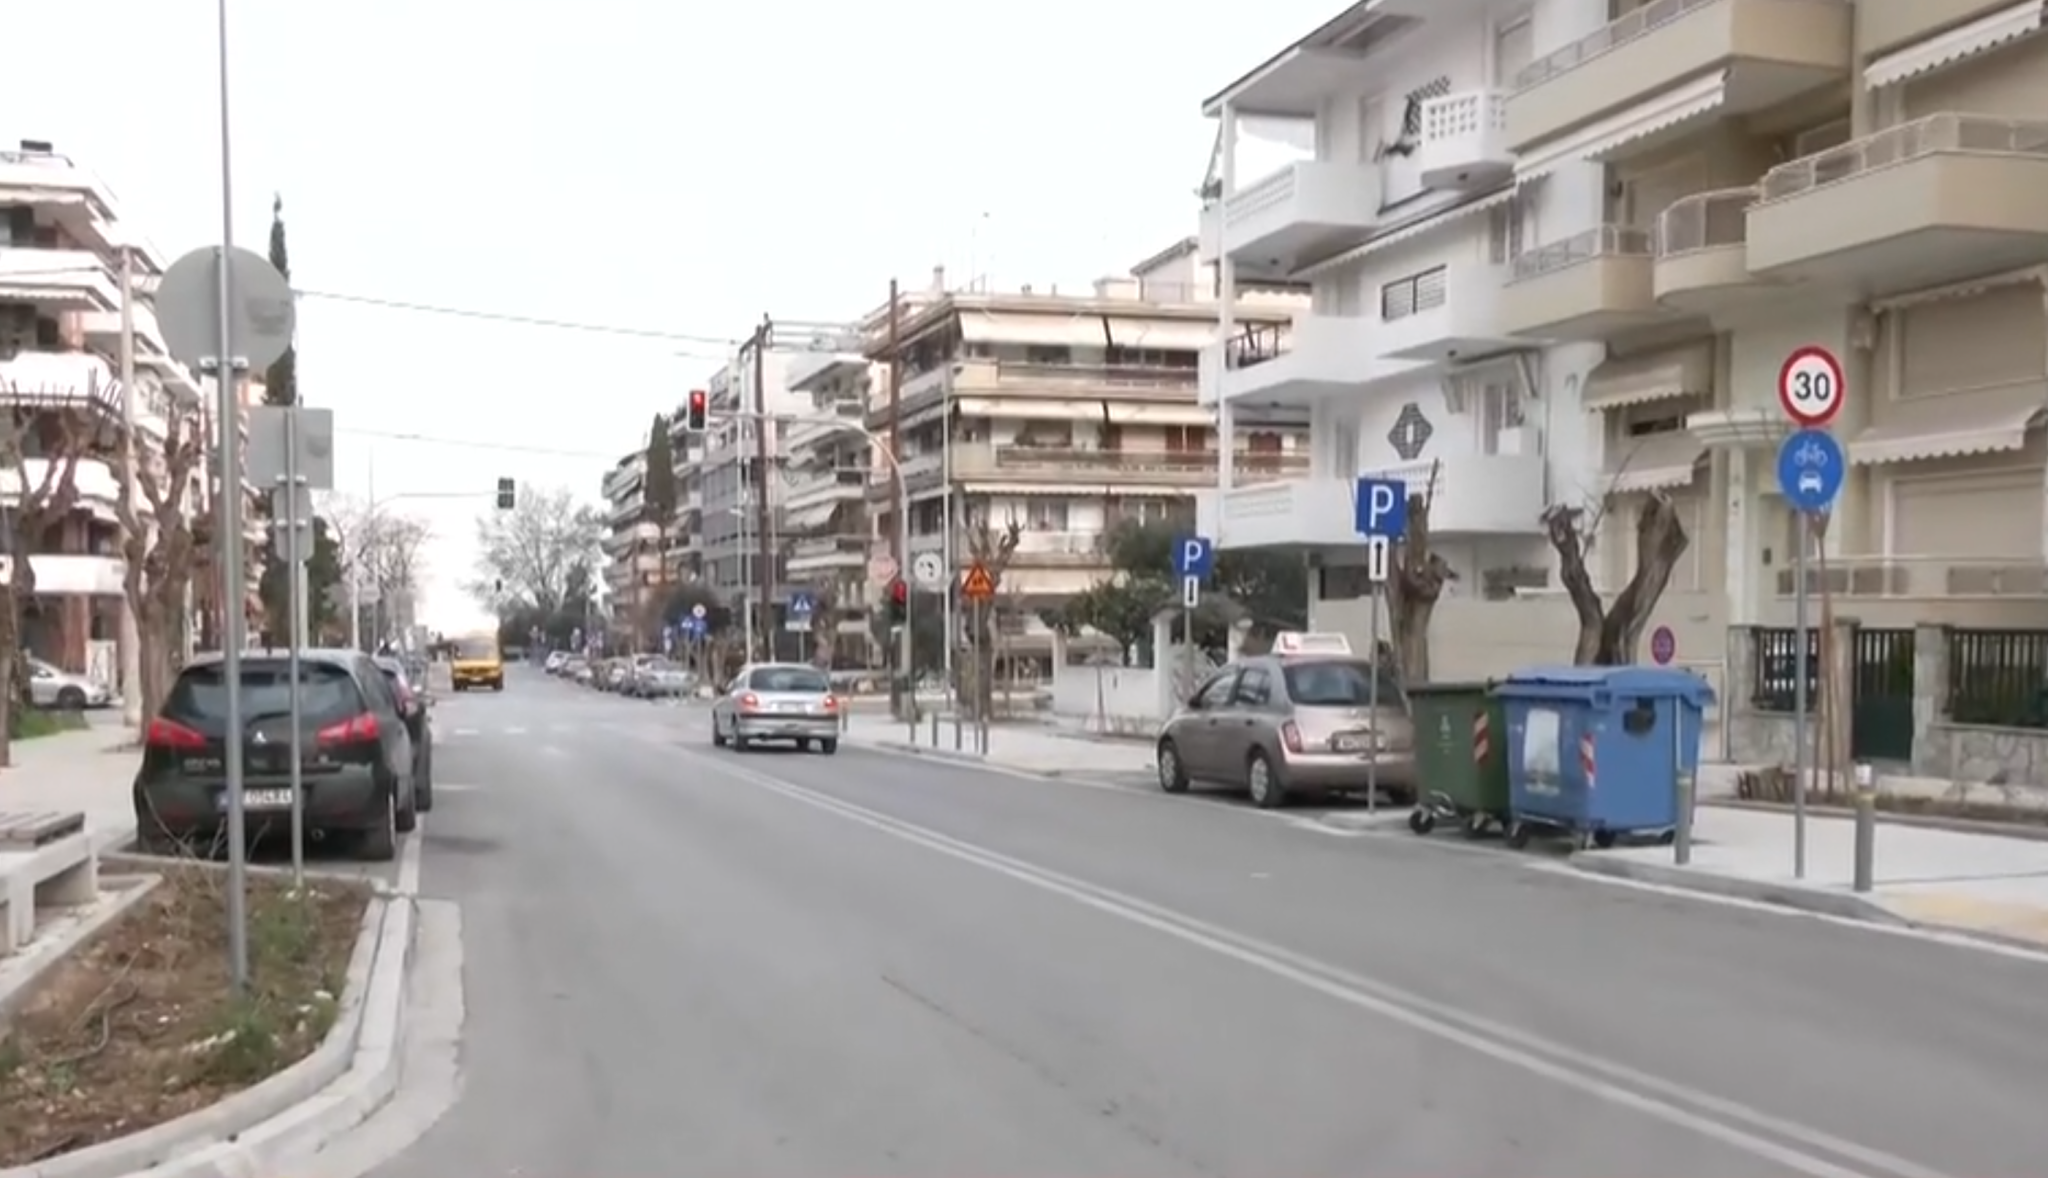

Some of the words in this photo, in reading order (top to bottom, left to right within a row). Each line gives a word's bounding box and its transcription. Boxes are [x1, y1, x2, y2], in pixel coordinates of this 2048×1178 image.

[1794, 371, 1831, 401] 30
[1370, 485, 1394, 529] P
[1184, 540, 1203, 571] P
